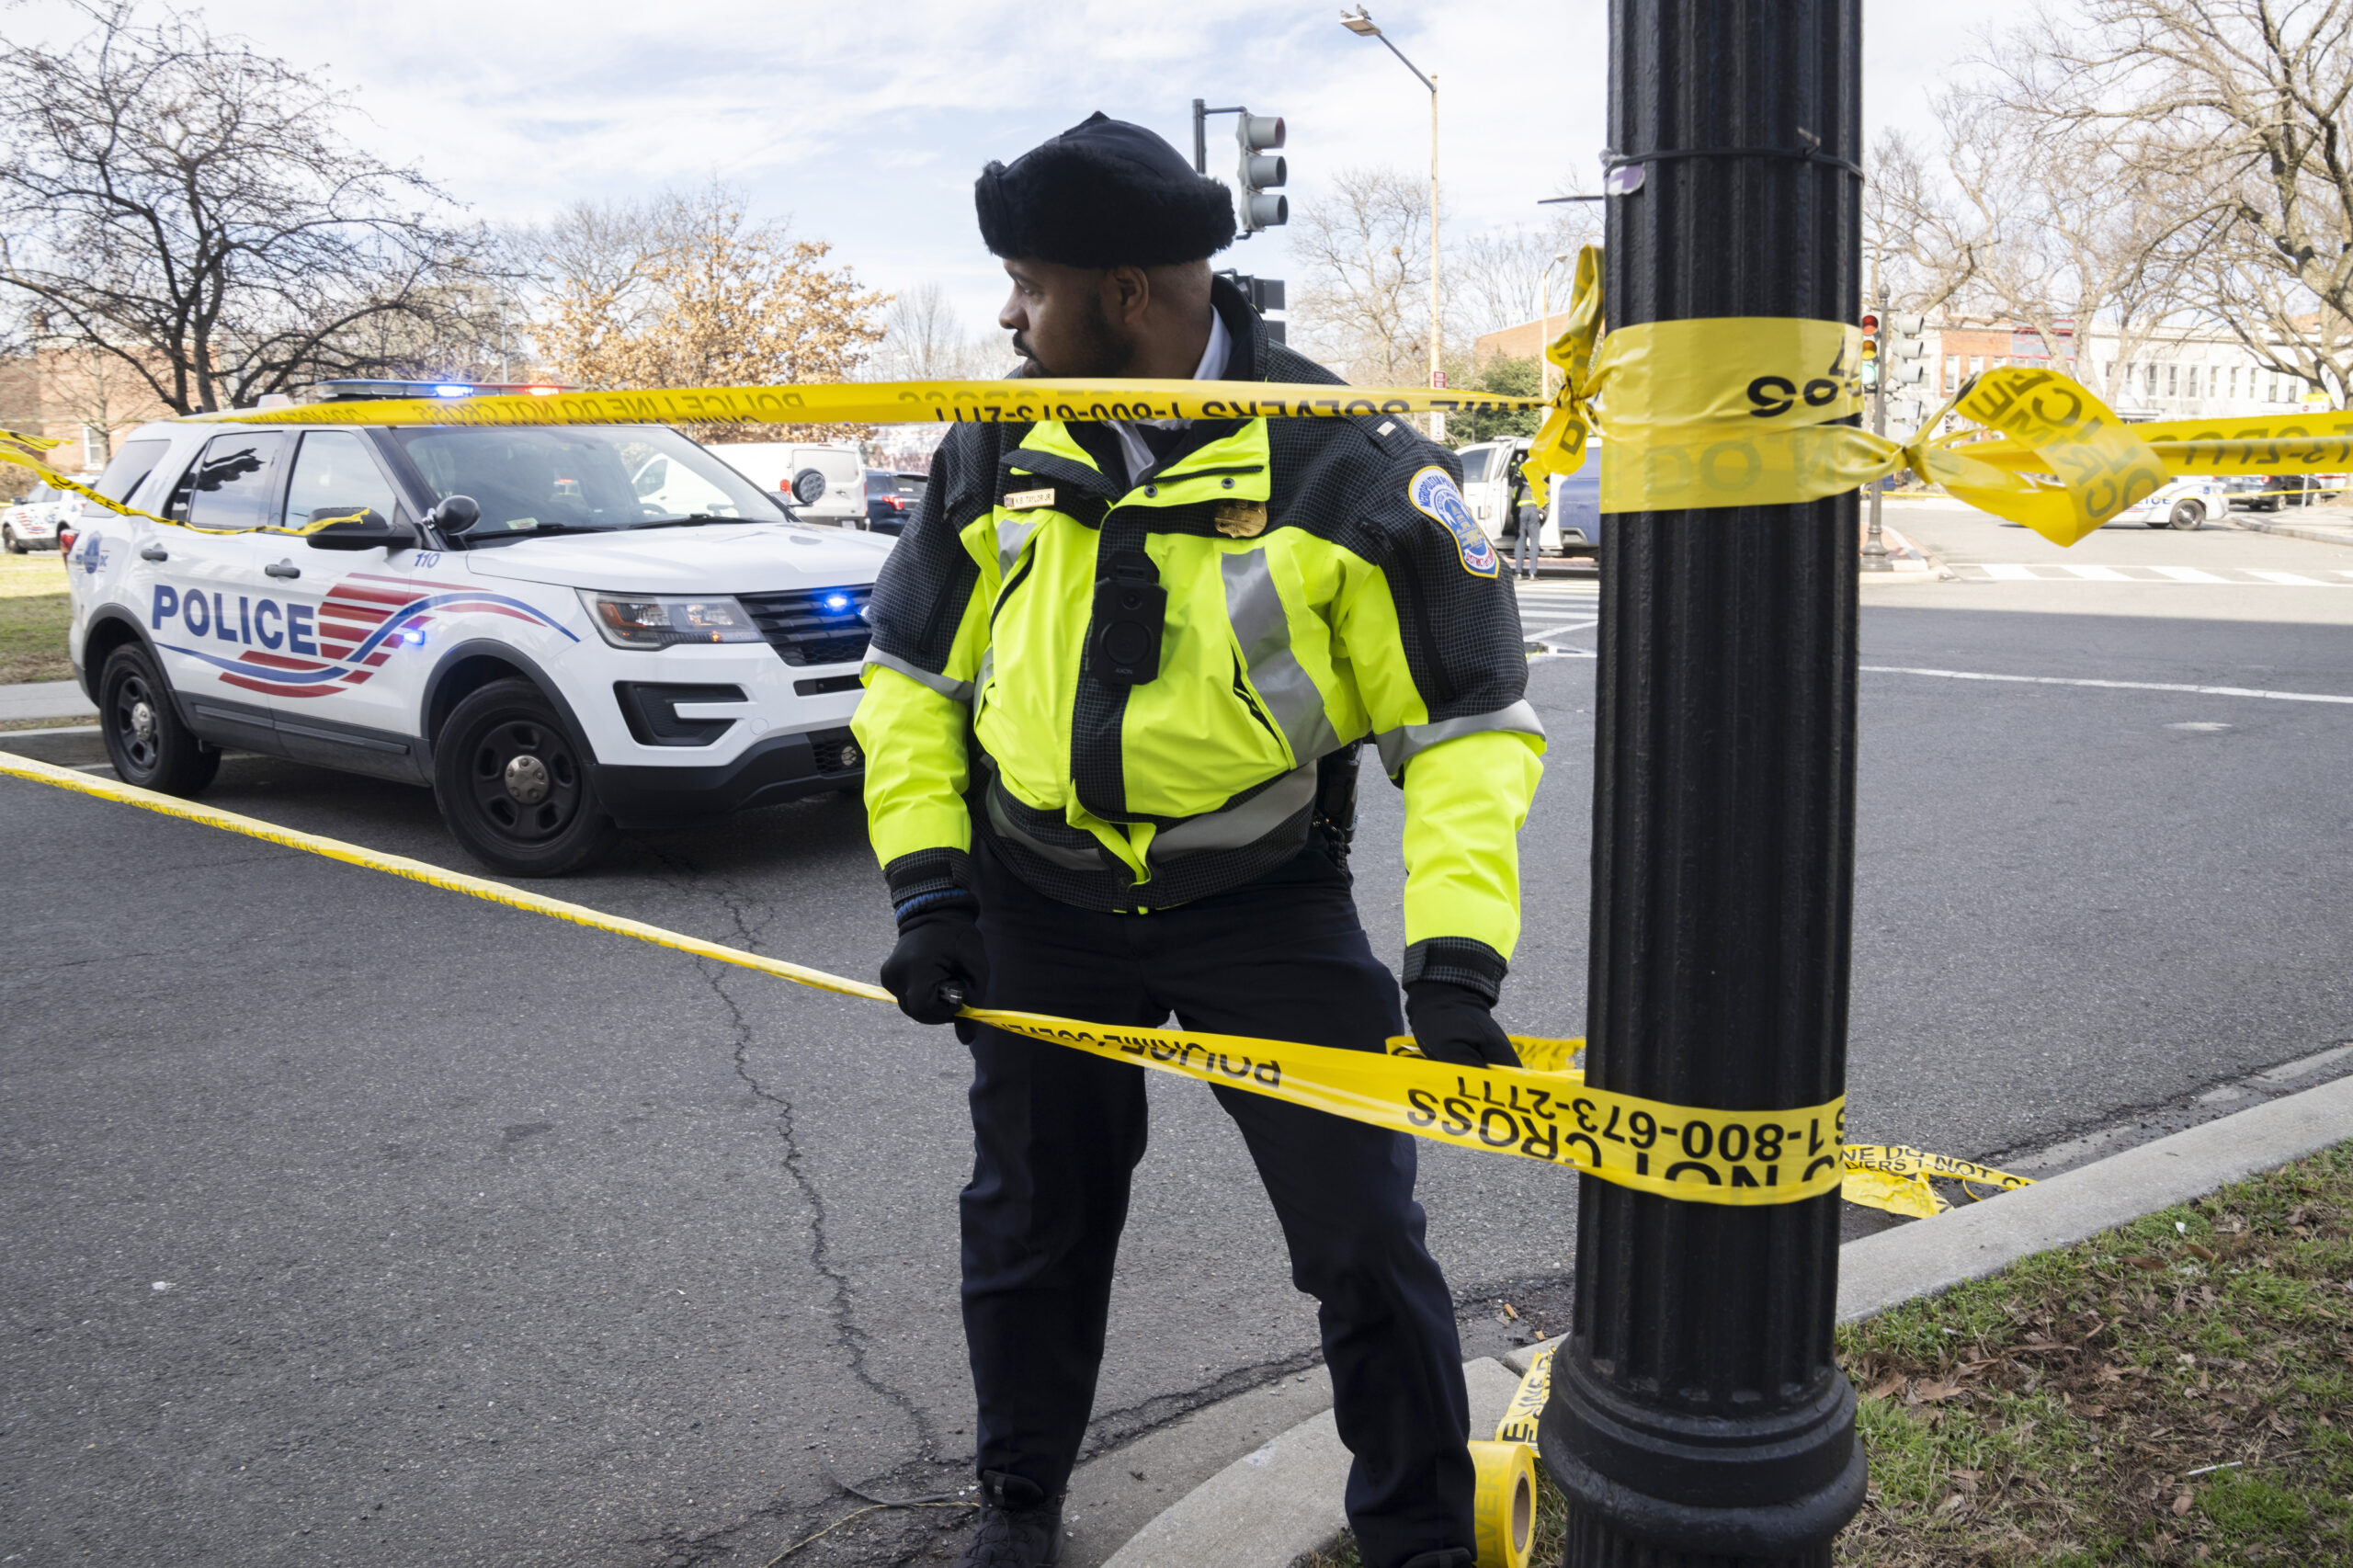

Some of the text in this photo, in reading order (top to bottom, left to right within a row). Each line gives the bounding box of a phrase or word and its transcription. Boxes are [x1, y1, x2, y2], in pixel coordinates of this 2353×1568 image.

[414, 551, 441, 569] 110
[152, 584, 318, 657] POLICE
[1407, 1088, 1602, 1167] CROSS
[1456, 1075, 1821, 1164] 1-800-673-2777
[1839, 1146, 1874, 1162] NE
[1936, 1154, 1995, 1180] NOT
